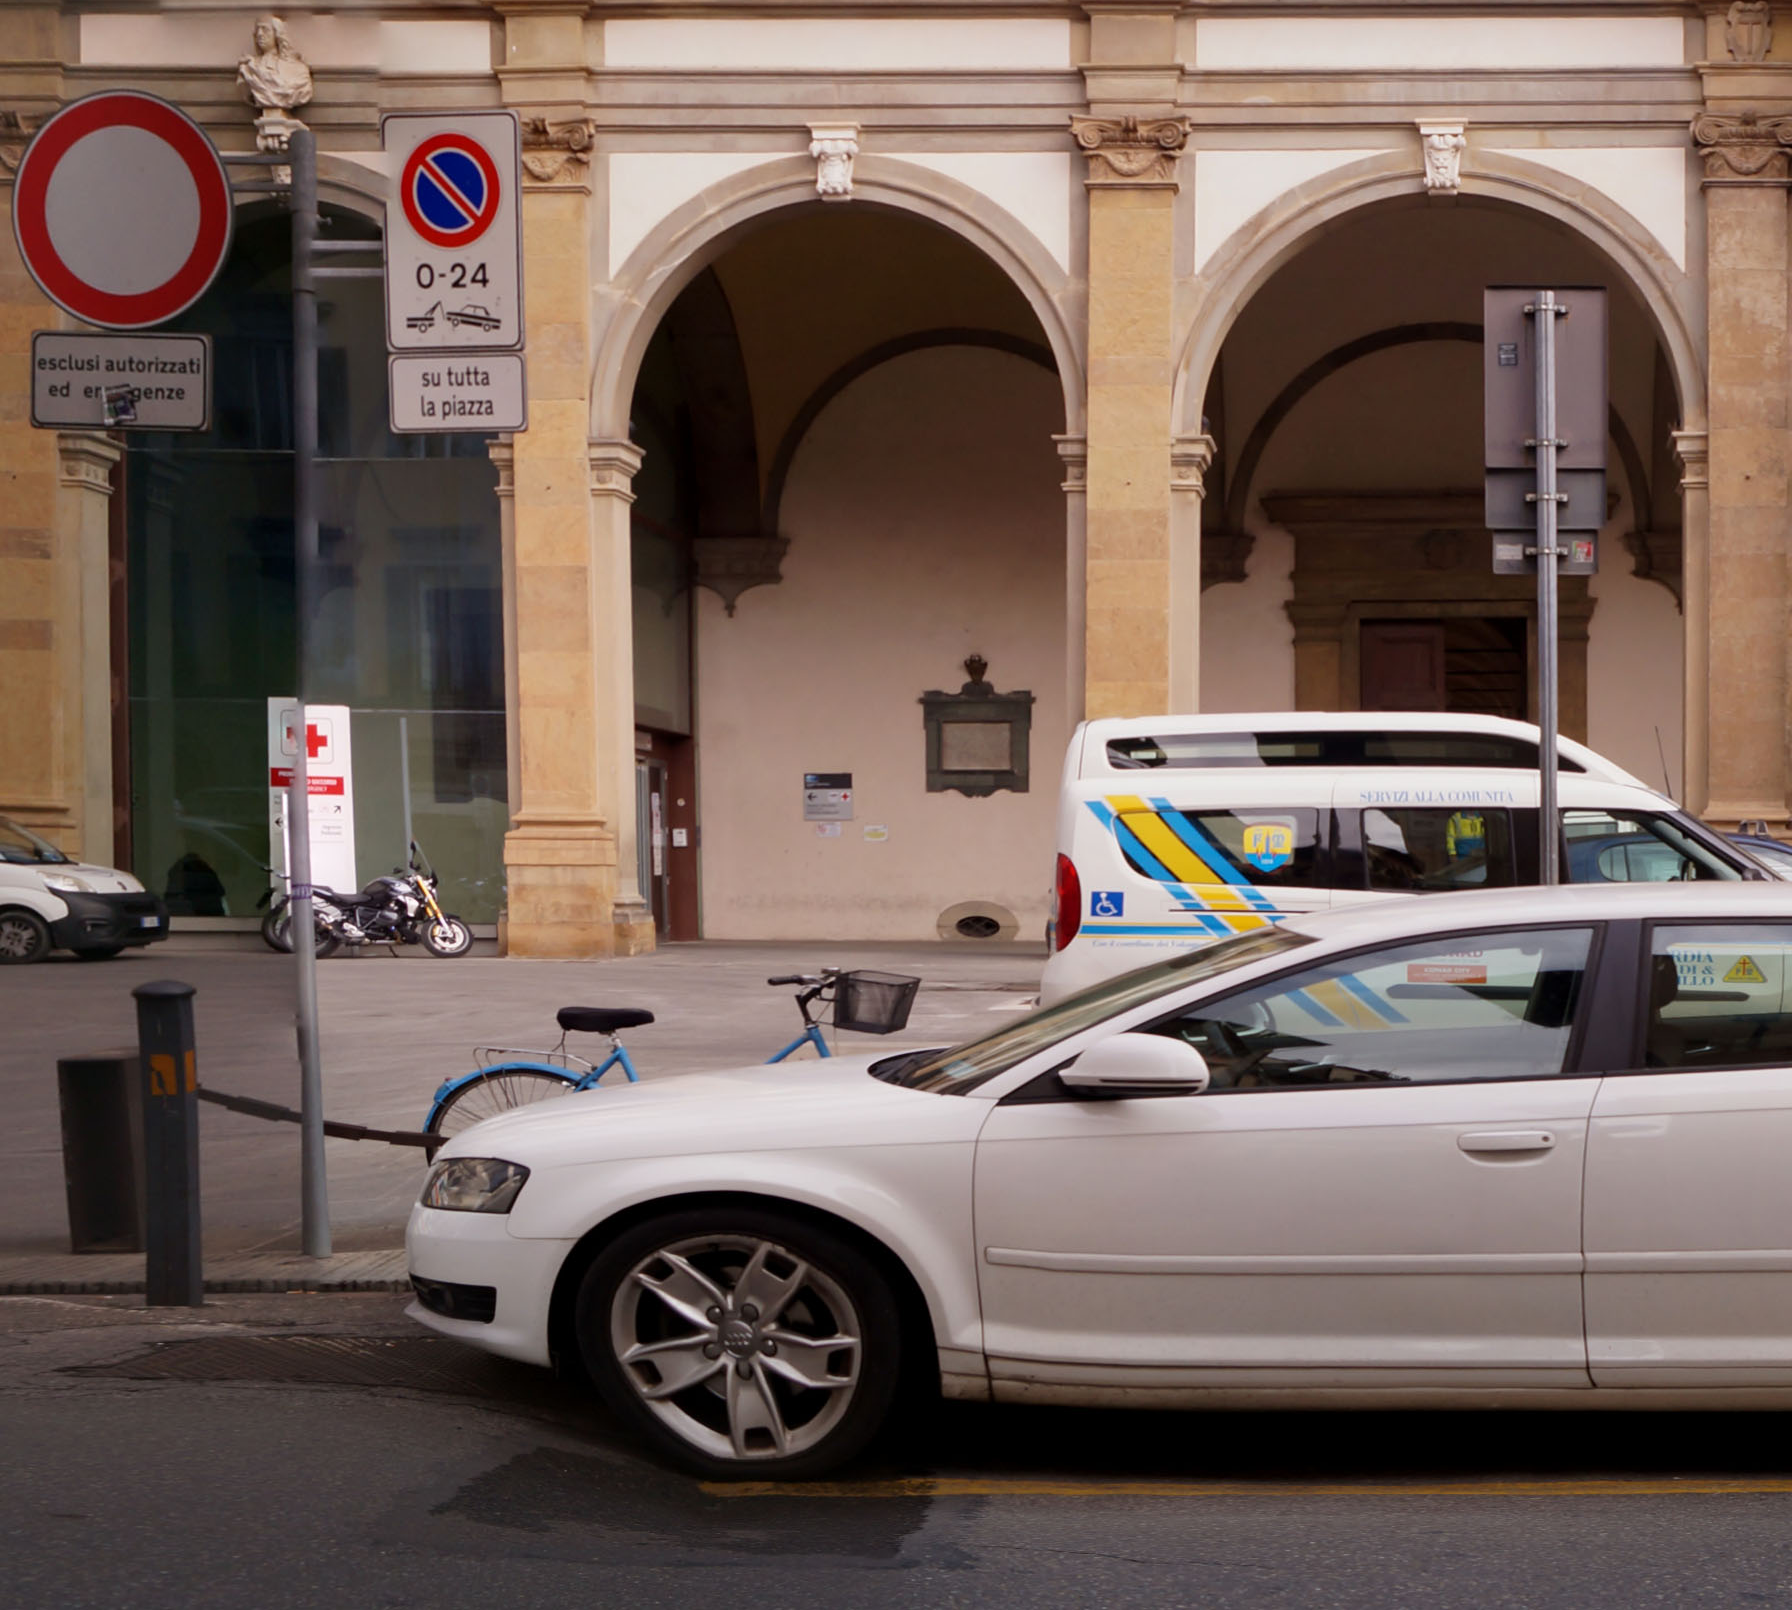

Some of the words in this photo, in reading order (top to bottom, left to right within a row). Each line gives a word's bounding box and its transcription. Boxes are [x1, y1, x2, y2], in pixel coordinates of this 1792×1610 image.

[416, 262, 489, 289] 0-24
[38, 355, 100, 371] esclusi
[105, 356, 201, 374] autorizzati
[422, 372, 441, 387] su
[447, 367, 490, 387] tutta
[48, 382, 70, 397] ed
[84, 386, 185, 401] egenze
[421, 395, 436, 417] la
[442, 395, 494, 420] piazza
[1360, 790, 1409, 803] SERVIZI
[1414, 790, 1445, 803] ALLA
[1671, 950, 1714, 963] RDIA
